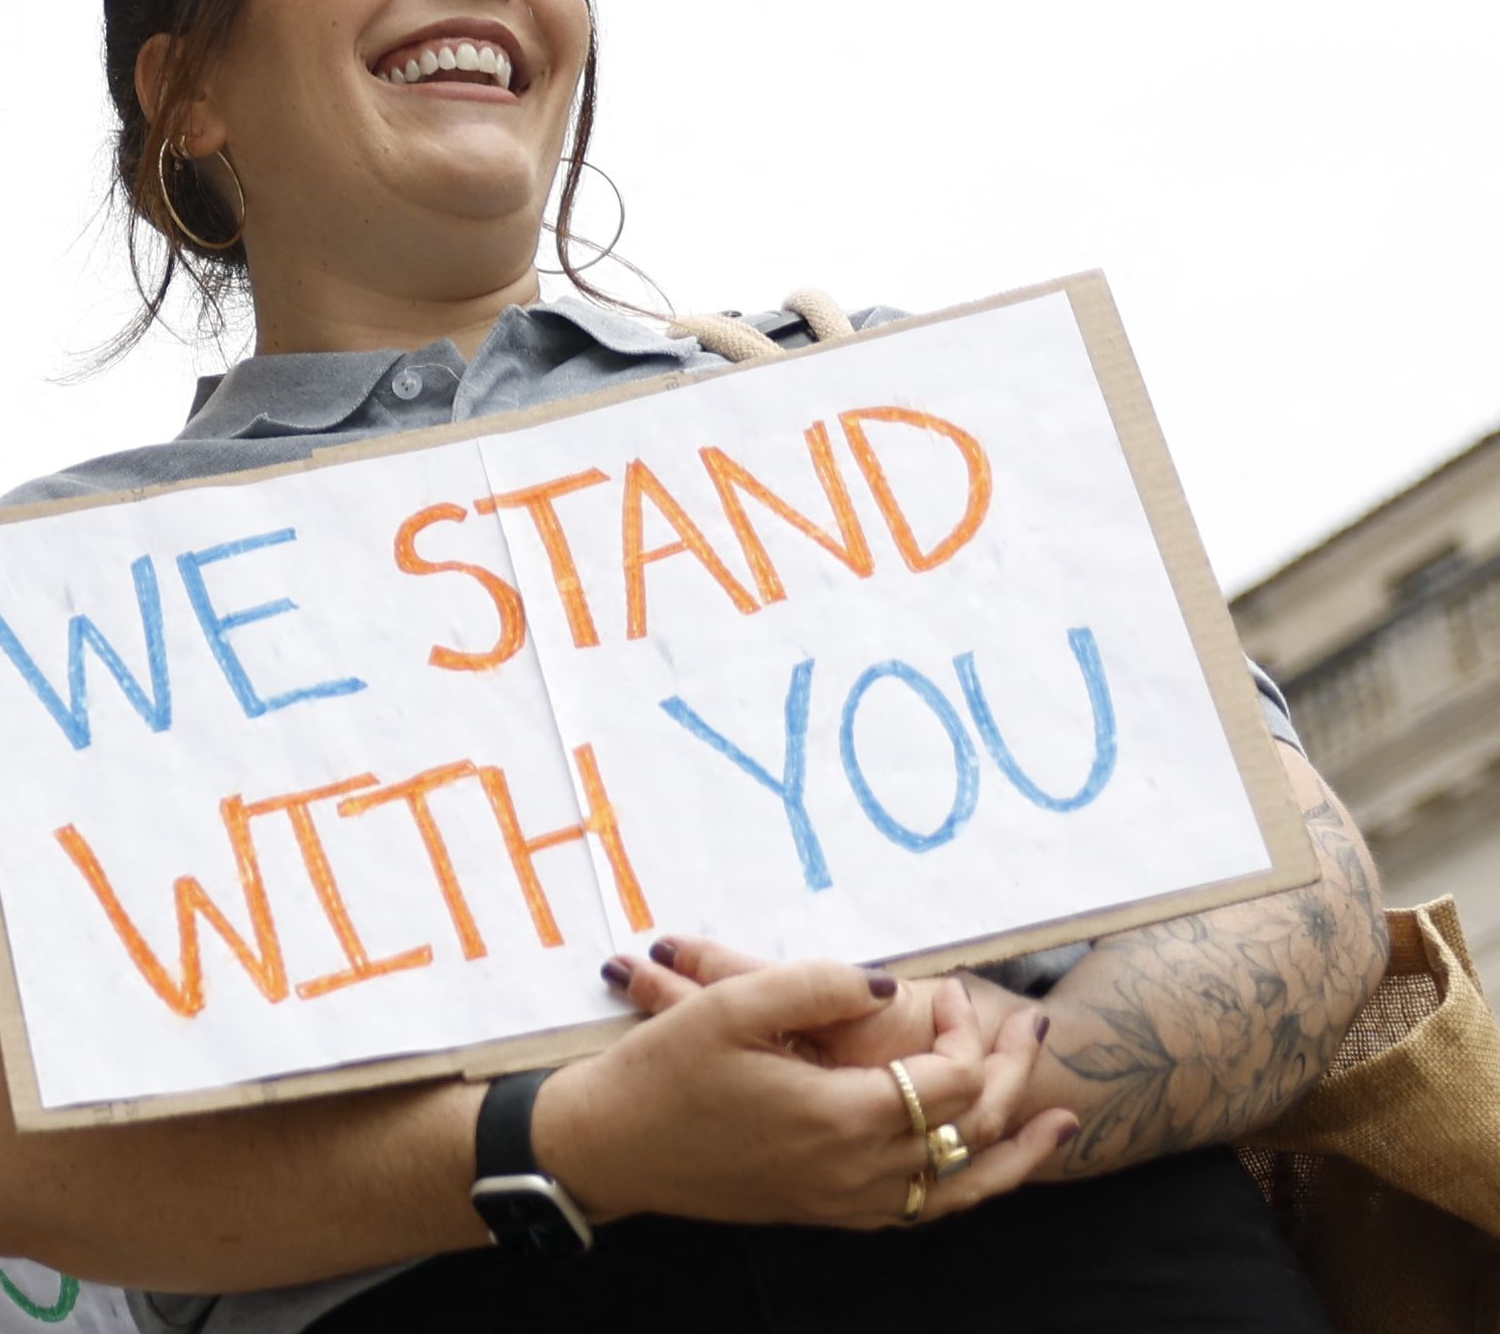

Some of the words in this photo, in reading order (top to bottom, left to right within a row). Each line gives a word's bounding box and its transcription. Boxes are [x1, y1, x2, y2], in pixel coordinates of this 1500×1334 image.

[394, 405, 994, 674] STAND
[54, 743, 656, 1020] WITH
[659, 627, 1120, 893] YOU
